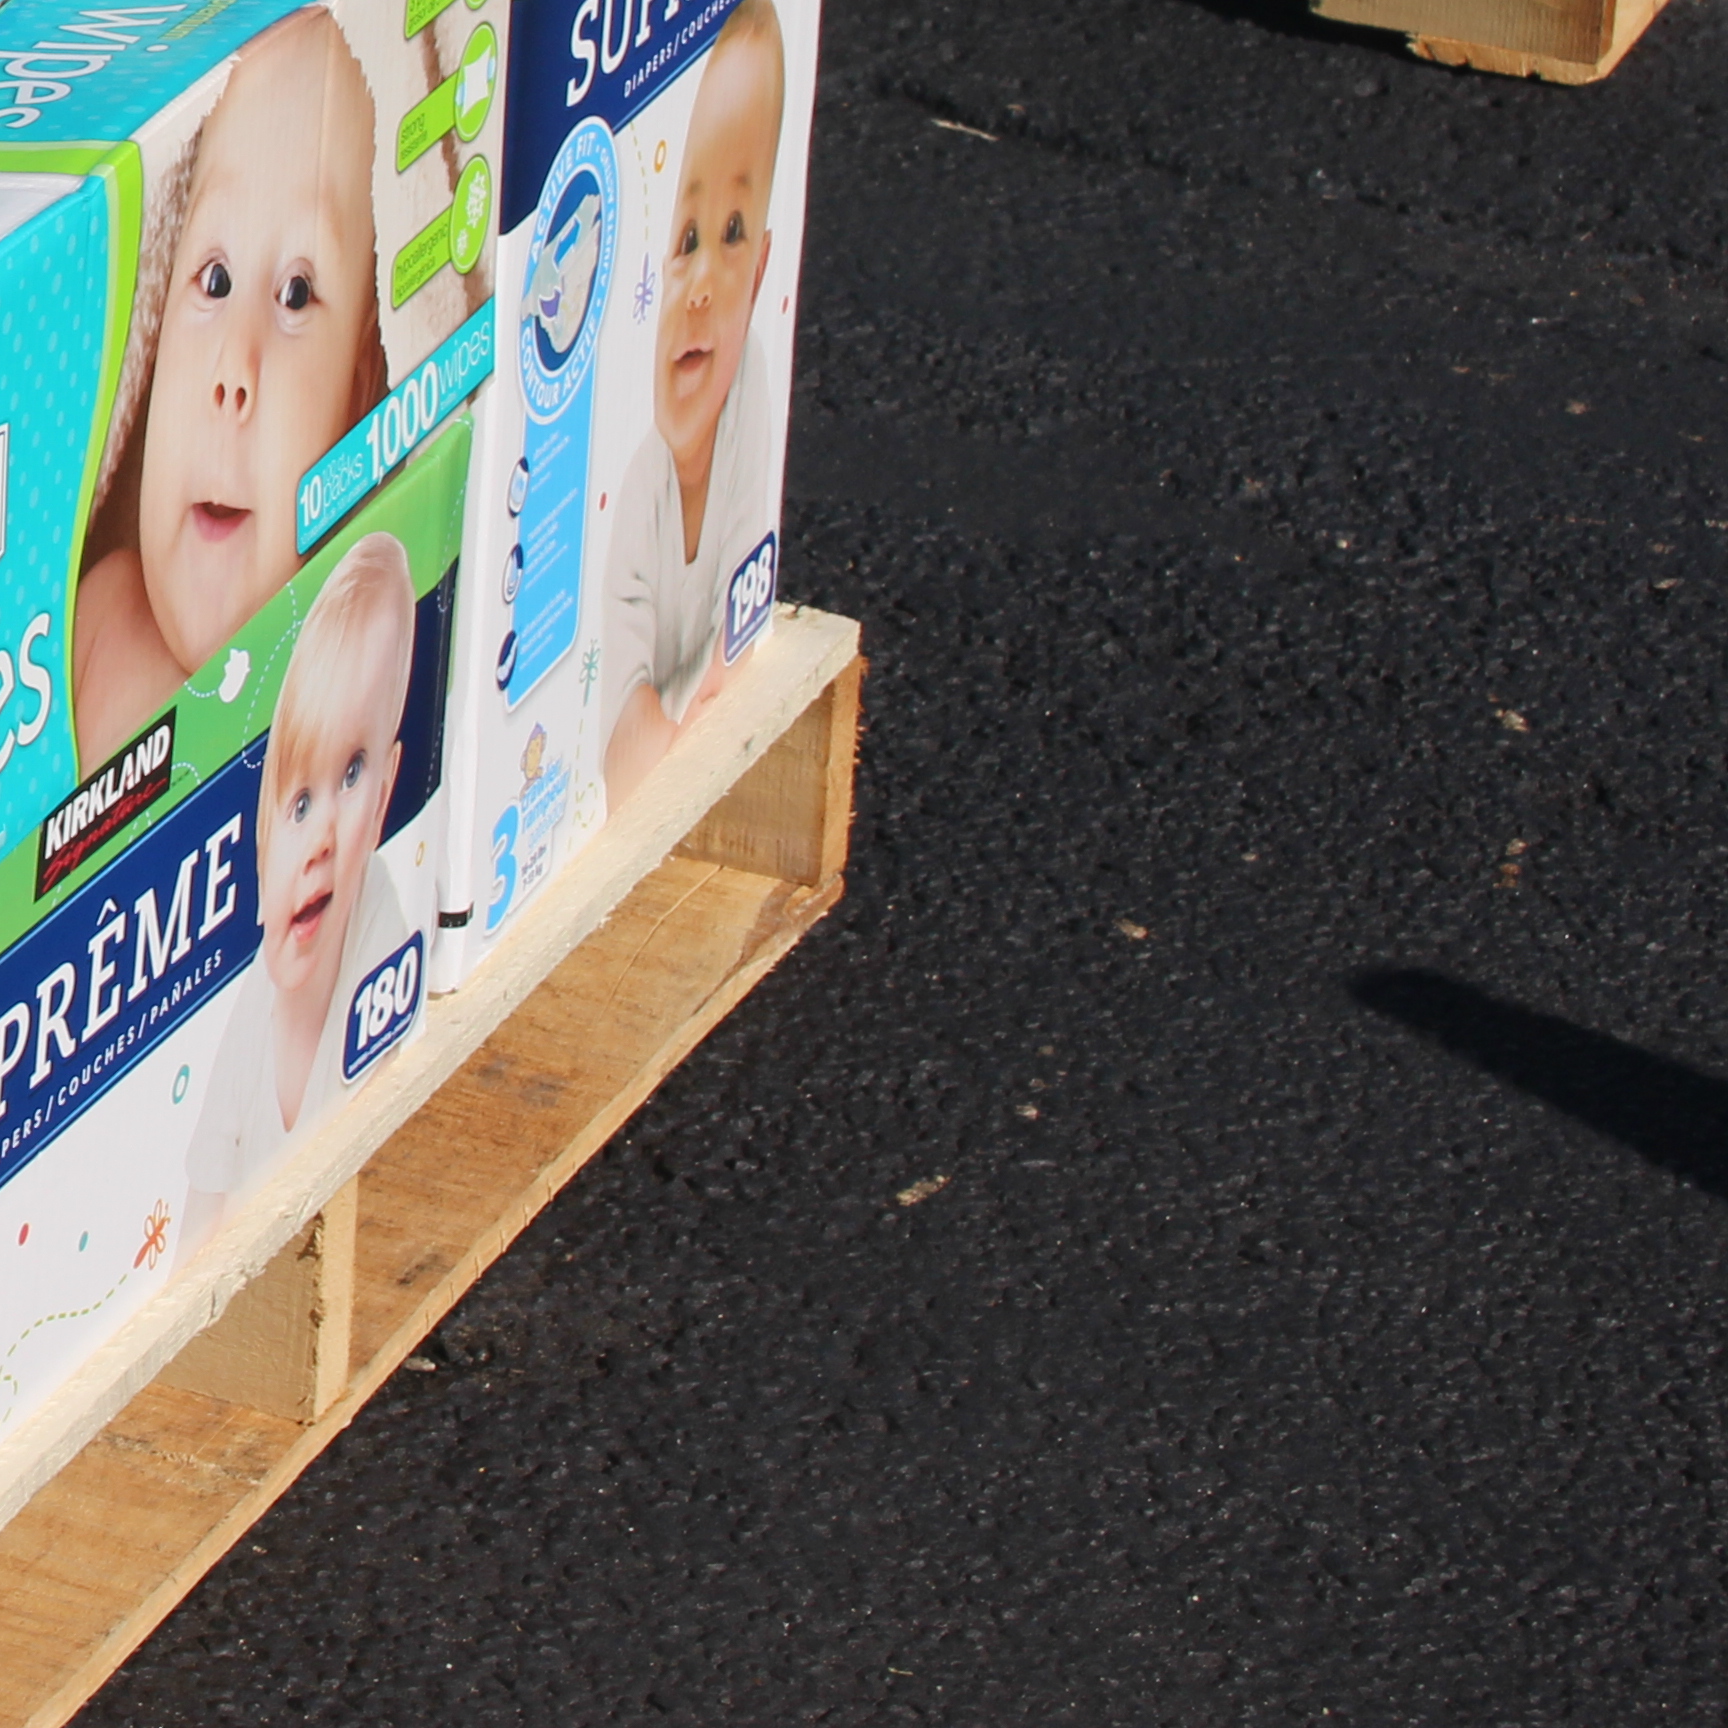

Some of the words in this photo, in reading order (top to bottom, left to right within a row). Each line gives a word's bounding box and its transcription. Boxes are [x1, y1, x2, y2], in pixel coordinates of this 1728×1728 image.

[729, 540, 776, 638] 198
[44, 723, 172, 860] KIRKLAND
[352, 951, 420, 1046] 180
